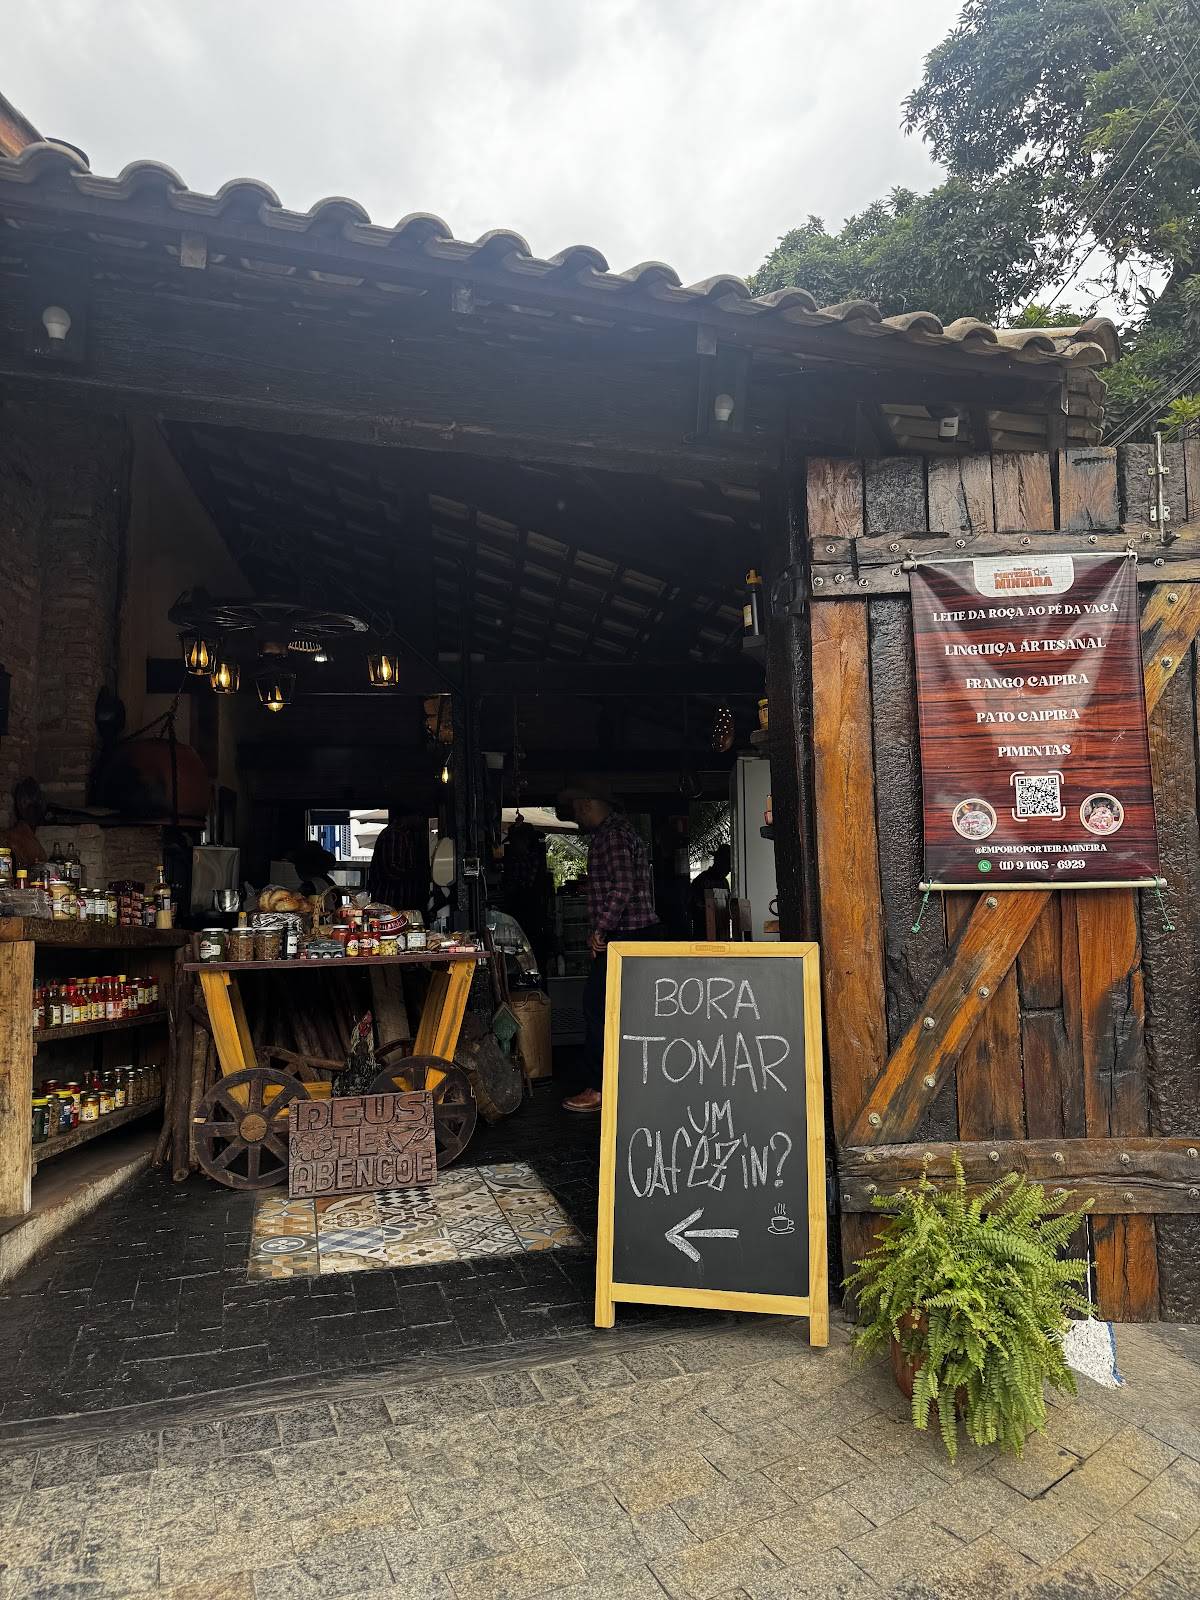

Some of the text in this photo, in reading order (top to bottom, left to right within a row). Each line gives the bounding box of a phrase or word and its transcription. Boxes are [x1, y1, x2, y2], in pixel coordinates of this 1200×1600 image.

[994, 576, 1053, 590] MINEIRA
[933, 602, 1119, 622] LEITE DA ROÇA AO PÉ DA VACA
[945, 642, 1017, 657] LINGUIÇA
[966, 673, 1090, 689] FRANGO CAIPIRA
[976, 708, 1081, 724] PATO CAIPIRA
[997, 743, 1072, 757] PIMENTAS
[974, 843, 1108, 855] @EMPORIOPORTEIRAMINEIRA
[999, 861, 1015, 871] (11)
[1026, 860, 1050, 870] 1105
[1056, 859, 1086, 870] 6929
[654, 977, 761, 1020] BORA
[622, 1032, 790, 1093] TOMAR
[296, 1093, 428, 1132] DEUS
[686, 1099, 735, 1139] UM
[333, 1127, 379, 1158] TE
